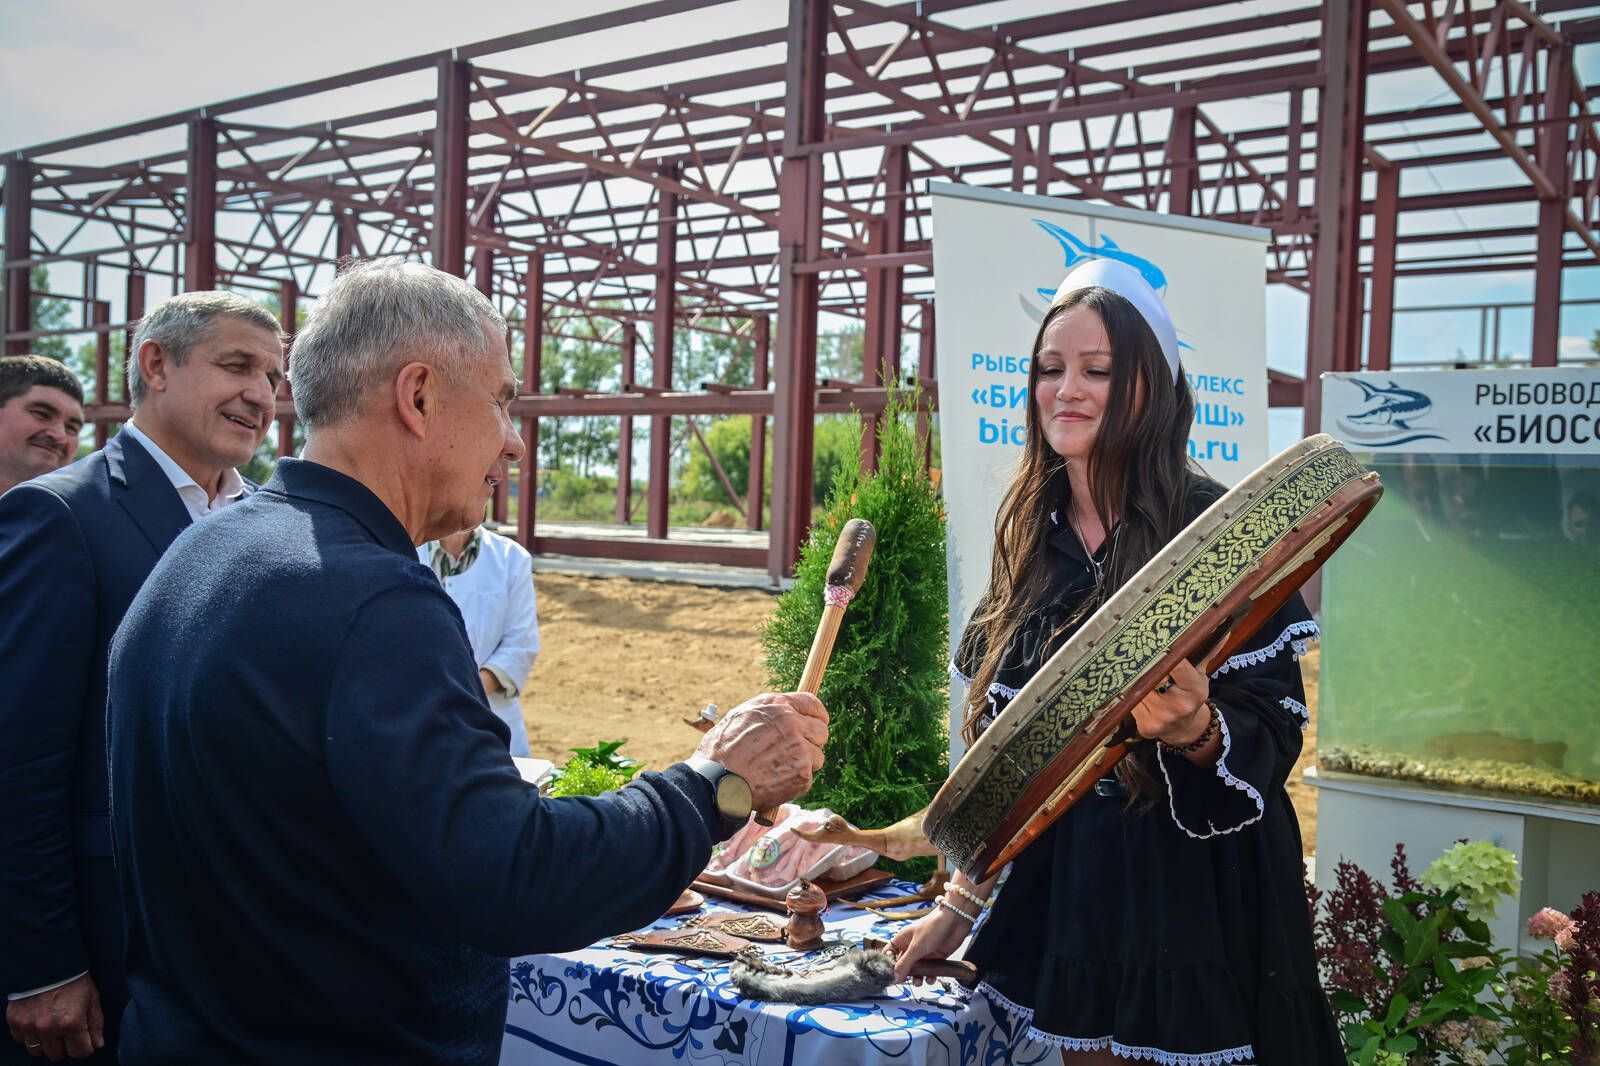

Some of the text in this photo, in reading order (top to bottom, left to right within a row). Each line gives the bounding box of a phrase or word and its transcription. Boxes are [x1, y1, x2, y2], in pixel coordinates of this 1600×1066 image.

[972, 353, 1031, 375] РЫБО
[971, 384, 1028, 409] «БИ
[979, 417, 1027, 446] bio
